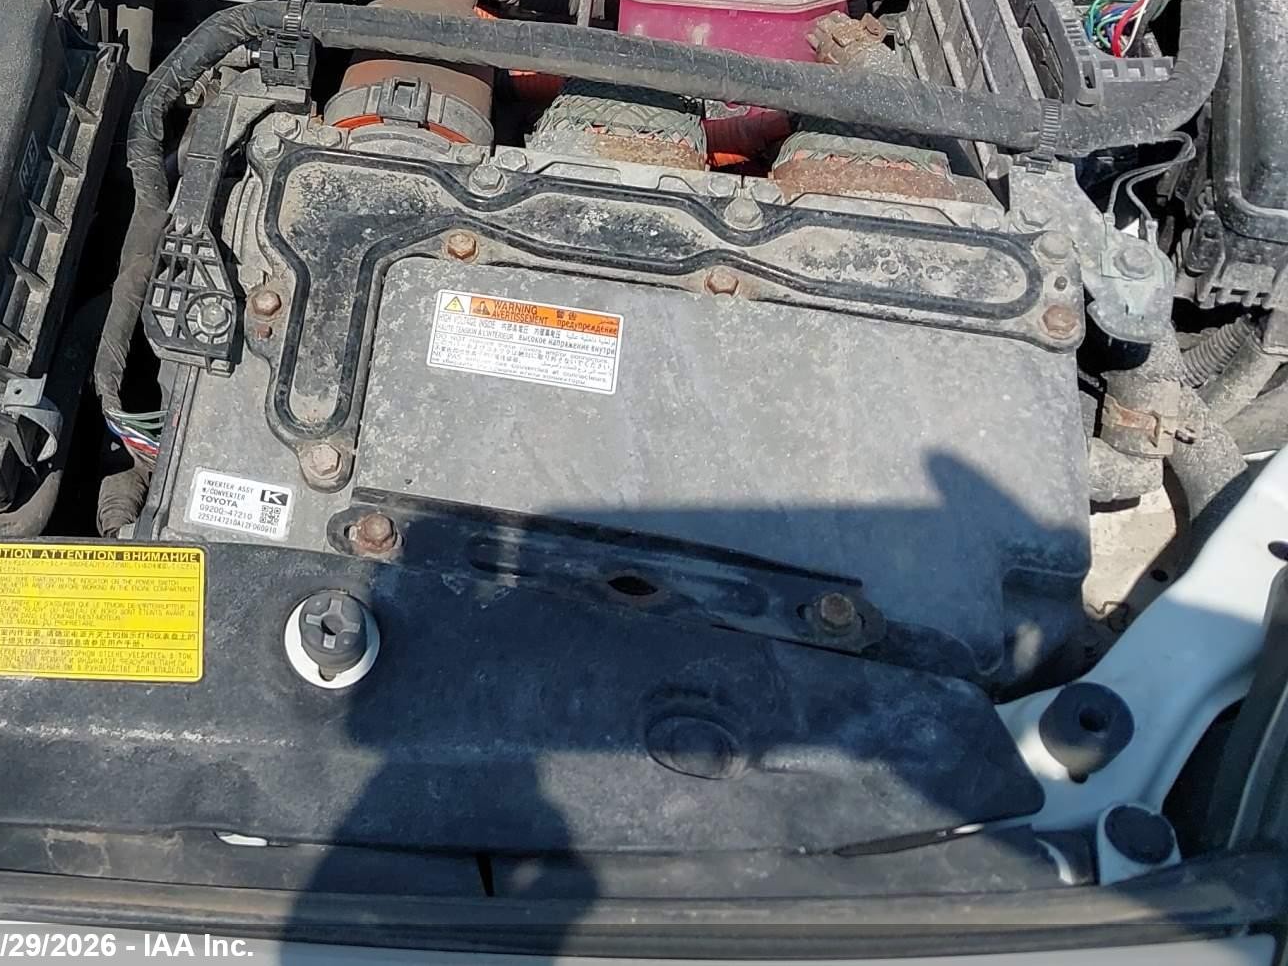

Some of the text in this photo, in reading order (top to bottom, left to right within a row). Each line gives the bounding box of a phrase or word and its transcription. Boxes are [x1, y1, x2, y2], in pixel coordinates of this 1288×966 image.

[495, 299, 538, 315] WARNING
[492, 310, 548, 325] AVERTISSEMENT
[203, 479, 234, 491] INVERTER
[200, 494, 238, 508] TOYOTA
[39, 549, 116, 560] ATTENTION
[122, 551, 197, 562] ВНИМАНИЕ
